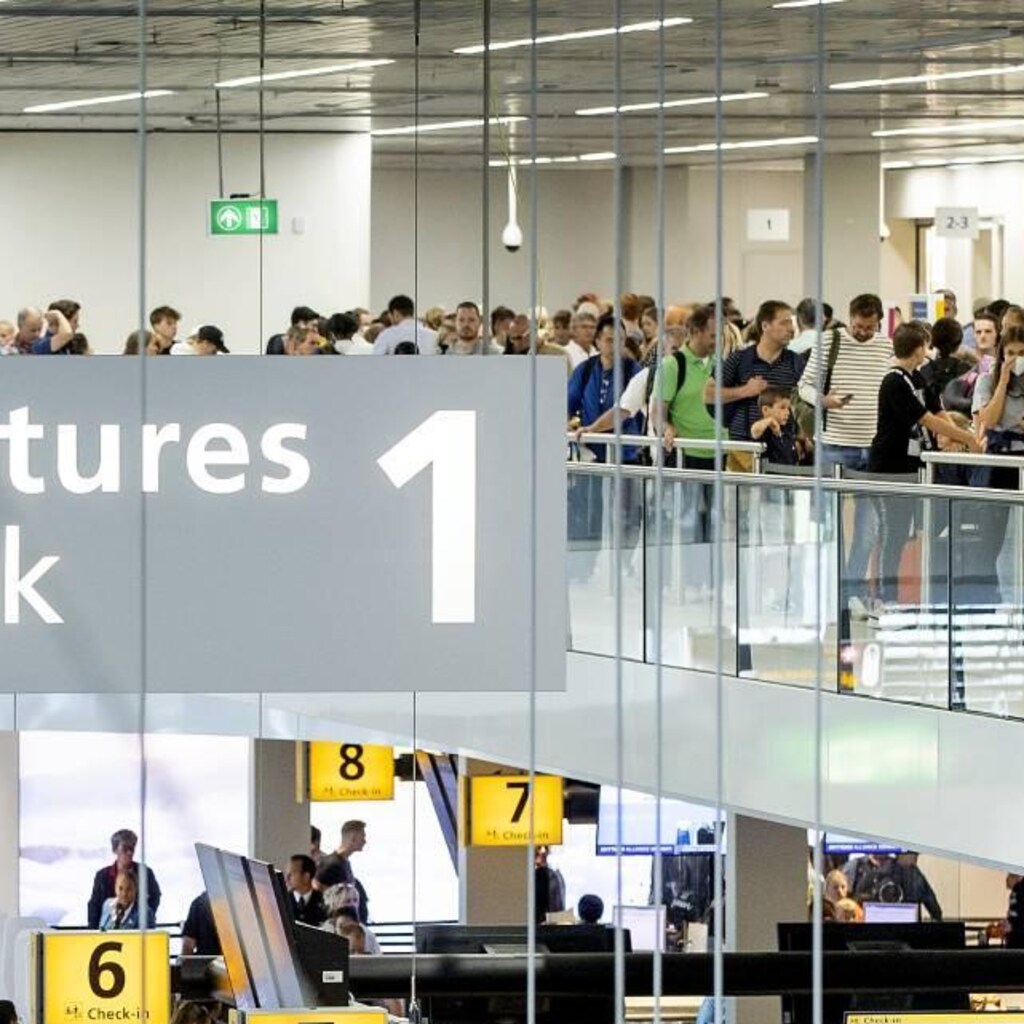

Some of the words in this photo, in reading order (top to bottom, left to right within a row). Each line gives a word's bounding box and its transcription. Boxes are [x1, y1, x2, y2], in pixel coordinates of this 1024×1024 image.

[945, 216, 970, 230] 2-3
[377, 409, 477, 624] 1
[339, 743, 365, 781] 8
[505, 782, 530, 824] 7
[502, 830, 549, 841] Chec-in
[88, 941, 126, 999] 6
[87, 1006, 150, 1021] Check-in
